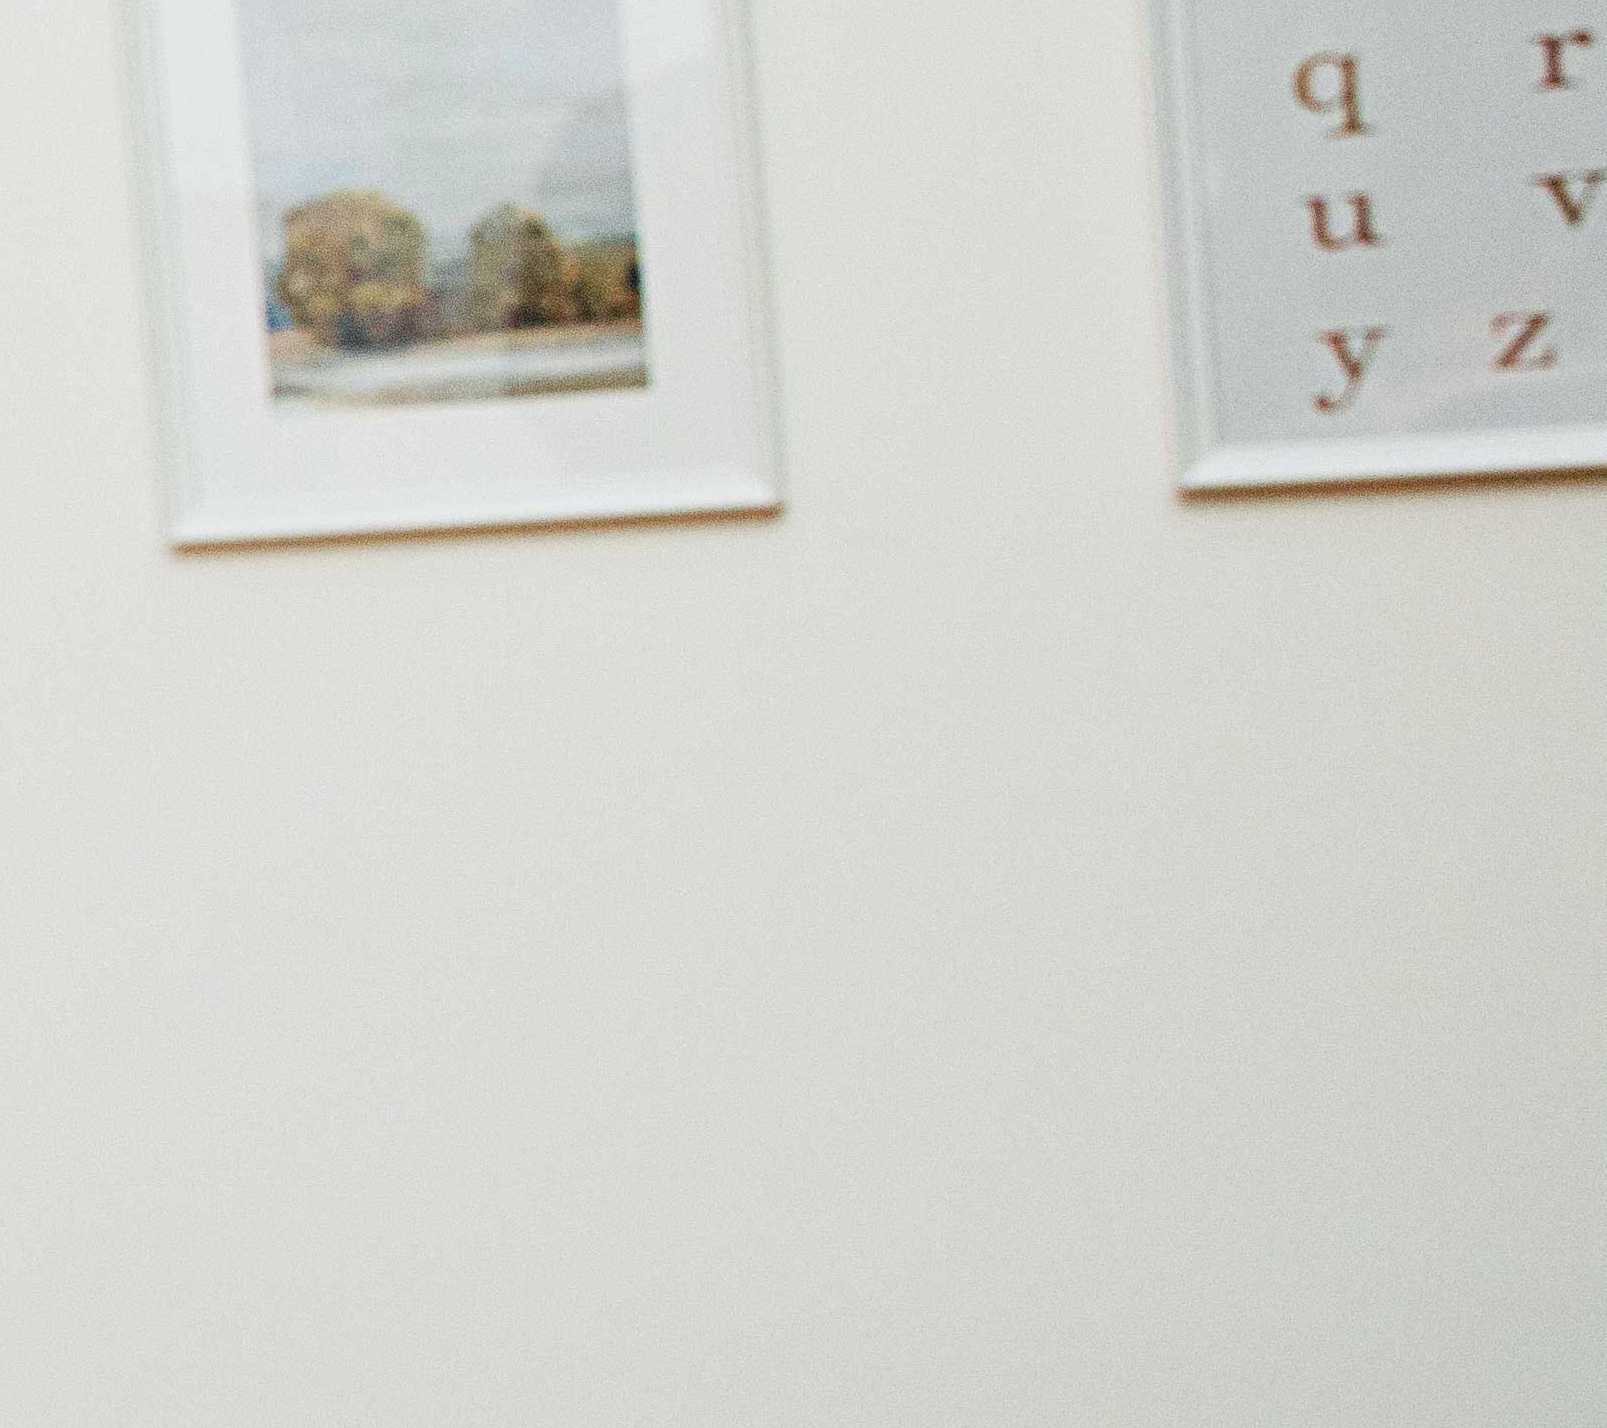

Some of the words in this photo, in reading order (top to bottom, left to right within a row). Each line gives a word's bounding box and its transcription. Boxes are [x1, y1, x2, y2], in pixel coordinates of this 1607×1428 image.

[1290, 51, 1372, 138] q
[1535, 28, 1596, 90] r
[1303, 189, 1384, 252] u
[1534, 170, 1607, 227] v
[1312, 326, 1386, 414] y
[1489, 310, 1557, 371] z
